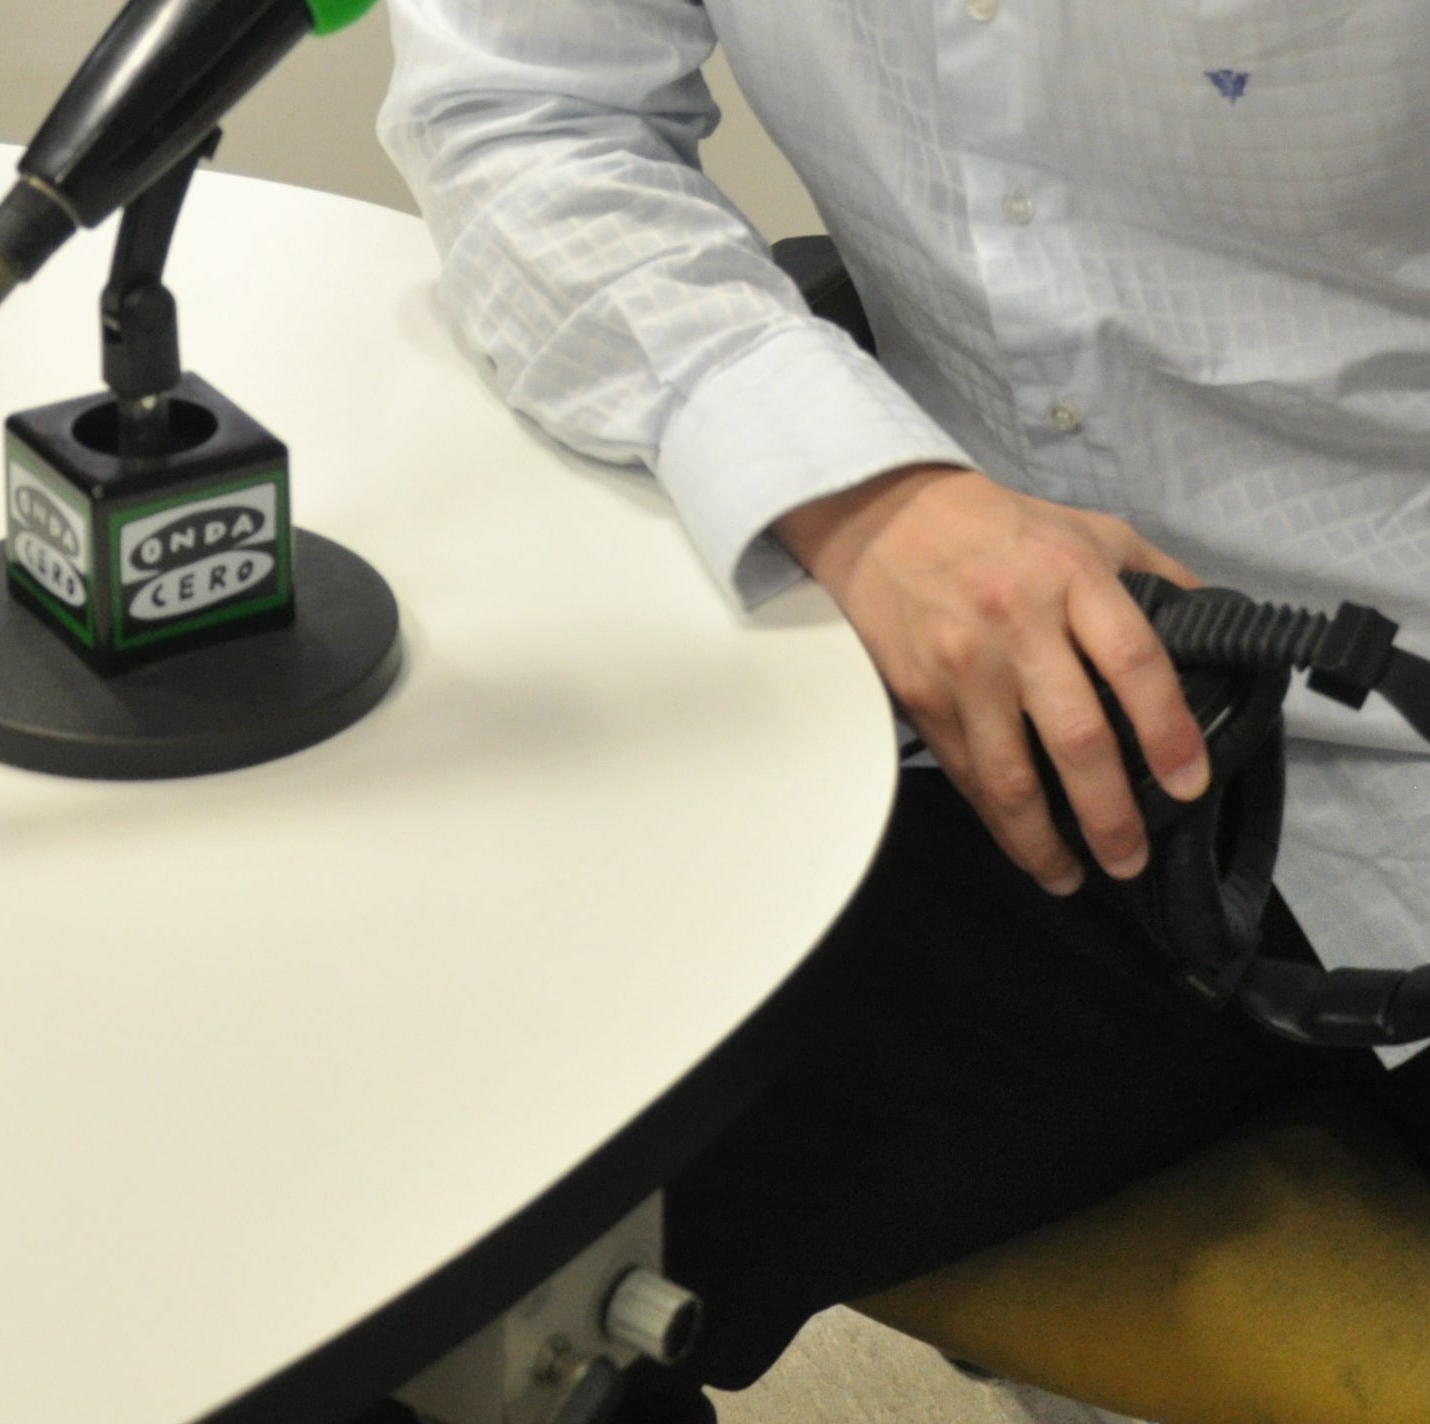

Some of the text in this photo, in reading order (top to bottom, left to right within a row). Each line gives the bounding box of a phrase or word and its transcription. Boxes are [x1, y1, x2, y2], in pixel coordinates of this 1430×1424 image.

[18, 488, 76, 553] ONDA
[139, 512, 255, 565] ONDA
[24, 538, 76, 597] CERO
[150, 559, 254, 608] CERO
